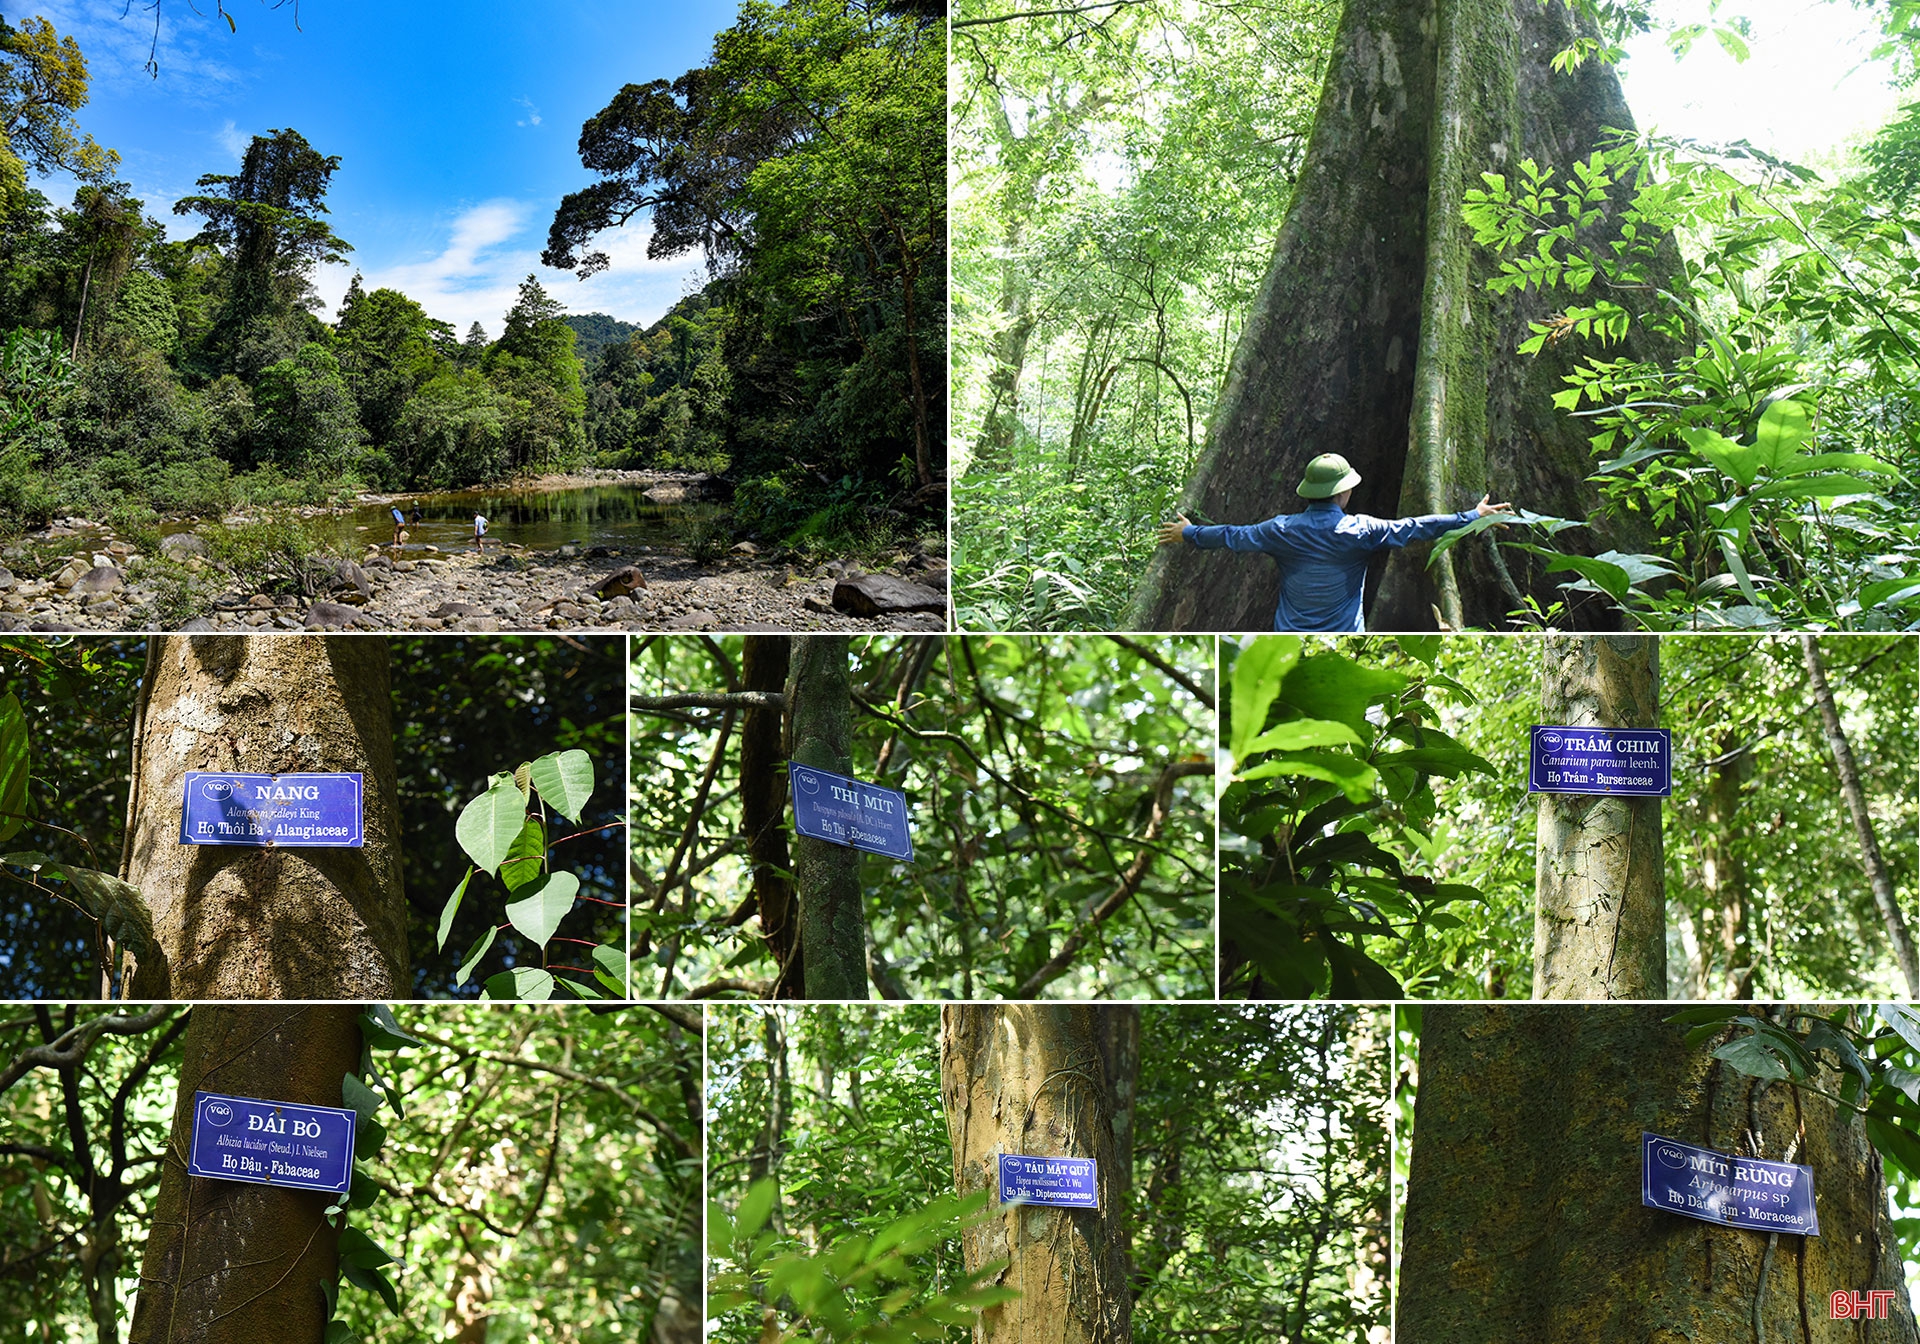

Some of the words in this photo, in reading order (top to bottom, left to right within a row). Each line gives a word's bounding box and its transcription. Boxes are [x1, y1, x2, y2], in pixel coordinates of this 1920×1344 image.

[1564, 735, 1612, 752] TRÁM
[1616, 740, 1659, 753] CHIM
[1542, 754, 1588, 767] Canarium
[1590, 759, 1626, 770] parvum
[1629, 757, 1659, 769] leenh.
[801, 775, 817, 785] VQG
[1548, 772, 1561, 785] Họ
[1563, 771, 1588, 783] Trám
[1597, 773, 1653, 785] Burseraceae
[208, 783, 229, 791] VQG
[256, 786, 319, 800] NANG
[831, 785, 859, 809] THỊ
[863, 793, 893, 814] MÍT
[300, 808, 320, 820] King
[197, 822, 214, 837] Họ
[218, 822, 245, 835] Thôi
[249, 823, 264, 836] Ba
[275, 823, 348, 839] Alangiaceae
[822, 819, 832, 836] Họ
[851, 826, 886, 846] Ebenaceae
[210, 1106, 229, 1116] VQG
[248, 1113, 287, 1134] ĐÁI
[292, 1117, 321, 1138] BÒ
[217, 1134, 241, 1147] Albizia
[302, 1148, 327, 1159] Nielsen
[1662, 1148, 1684, 1160] VQG
[222, 1154, 238, 1172] Họ
[240, 1157, 262, 1174] Đậu
[271, 1160, 320, 1179] Fabaceae
[1690, 1155, 1728, 1177] MÍT
[1734, 1164, 1793, 1188] RỪNG
[1036, 1189, 1092, 1200] Dipterocarpaceae
[1689, 1176, 1768, 1202] Artocarpus
[1772, 1193, 1790, 1207] sp
[1668, 1189, 1684, 1207] Họ
[1688, 1194, 1710, 1210] Dâu
[1749, 1208, 1804, 1224] Moraceae
